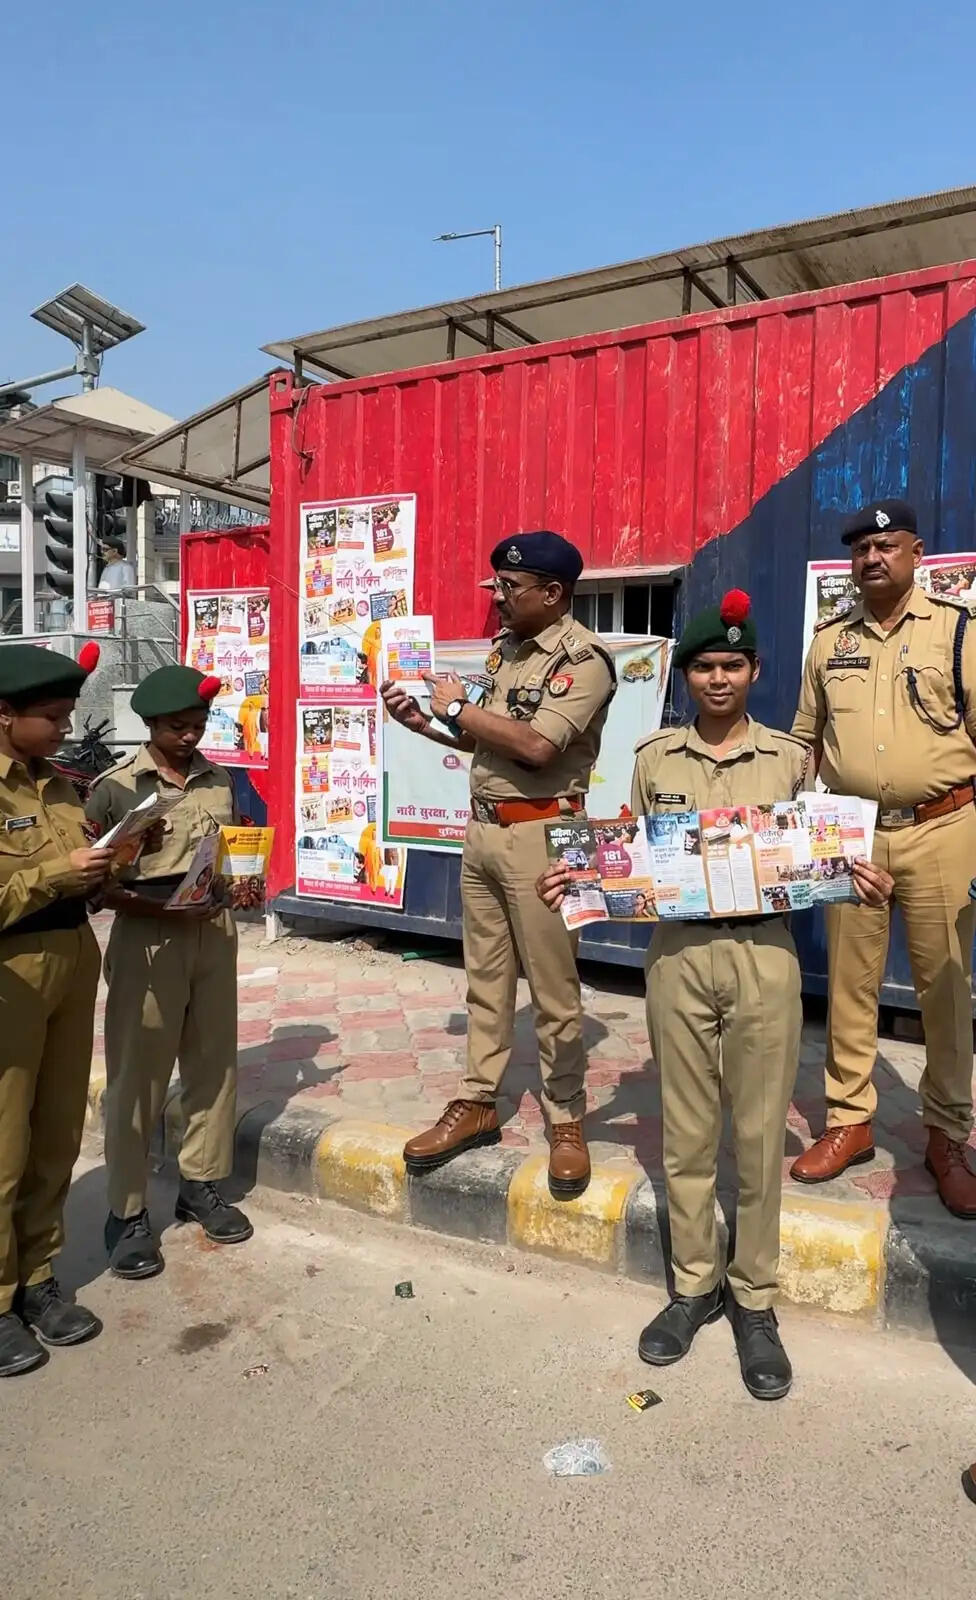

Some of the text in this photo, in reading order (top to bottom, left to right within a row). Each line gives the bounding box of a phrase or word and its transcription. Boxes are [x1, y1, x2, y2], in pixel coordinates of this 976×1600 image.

[820, 577, 847, 587] महिला
[821, 587, 844, 599] सुरक्षा
[396, 804, 417, 816] नारी
[420, 807, 449, 820] सुरक्षा,
[602, 850, 622, 861] 181
